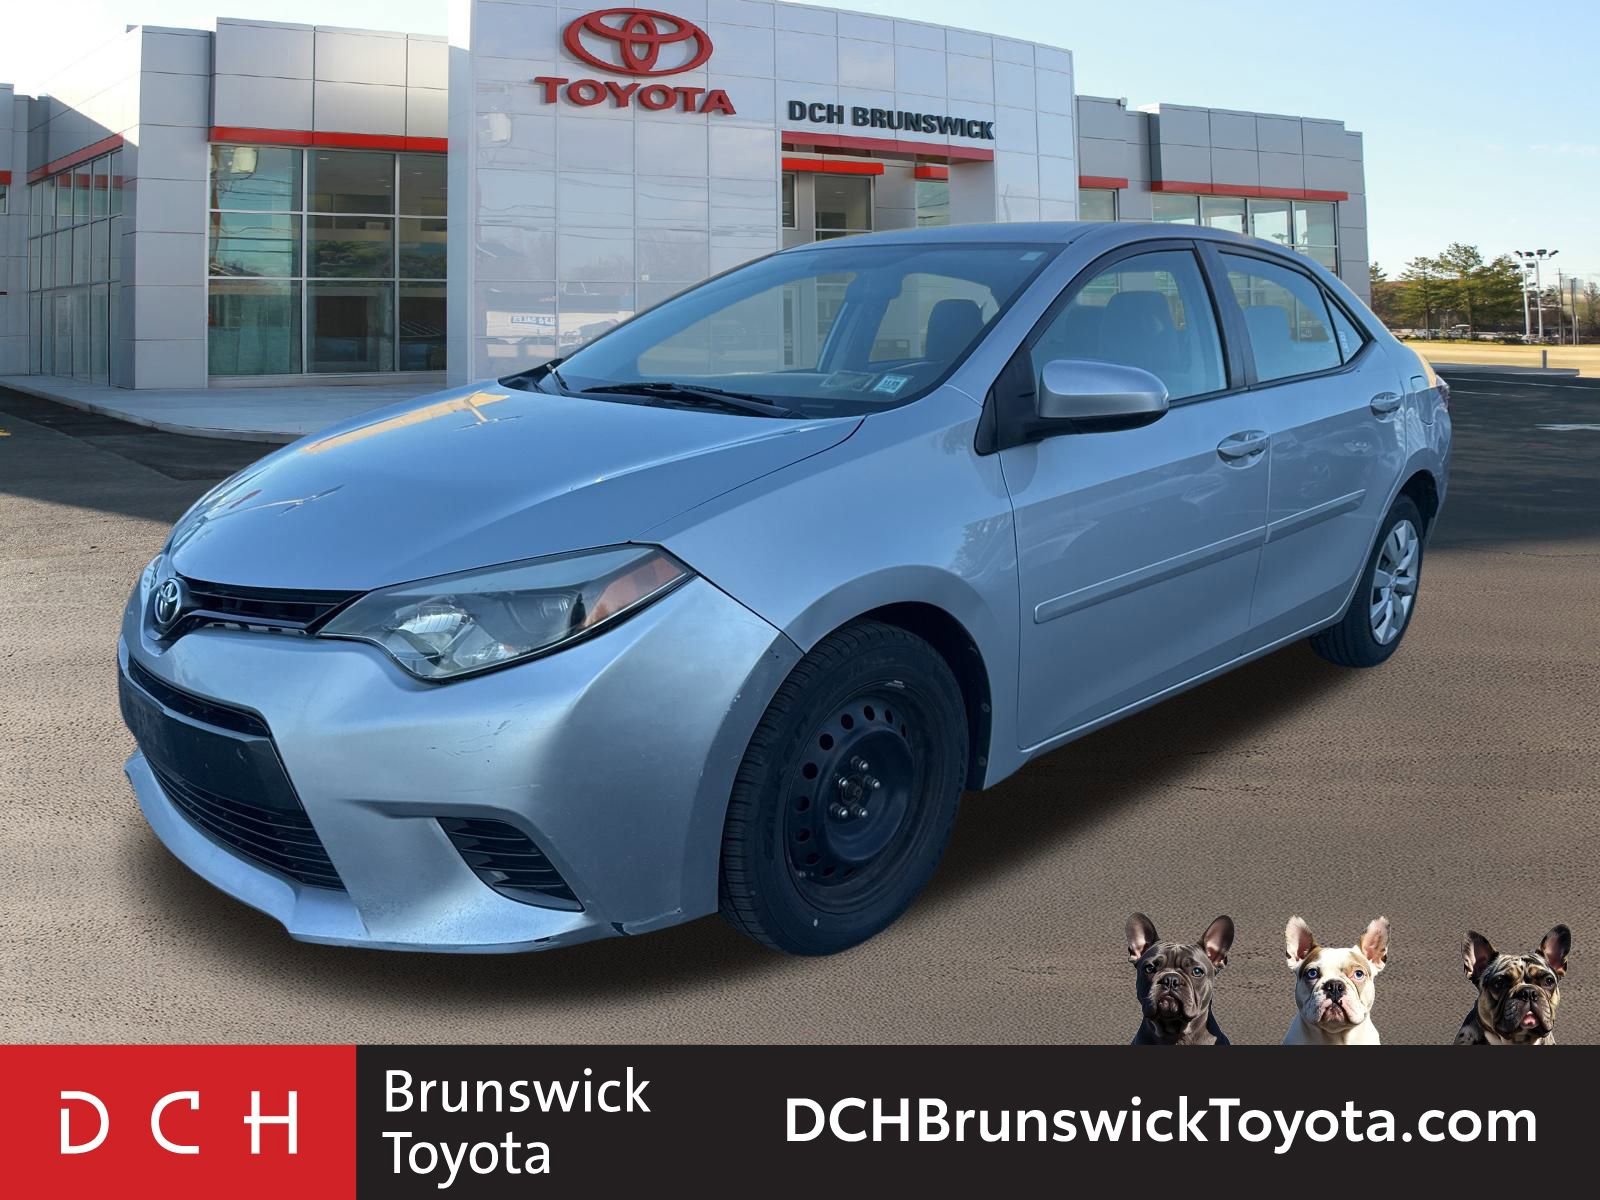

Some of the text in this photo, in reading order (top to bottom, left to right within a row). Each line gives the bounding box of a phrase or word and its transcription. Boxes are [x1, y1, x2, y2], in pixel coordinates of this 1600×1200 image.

[534, 76, 736, 115] TOYOTA
[789, 100, 994, 140] DCH BRUNSWICK
